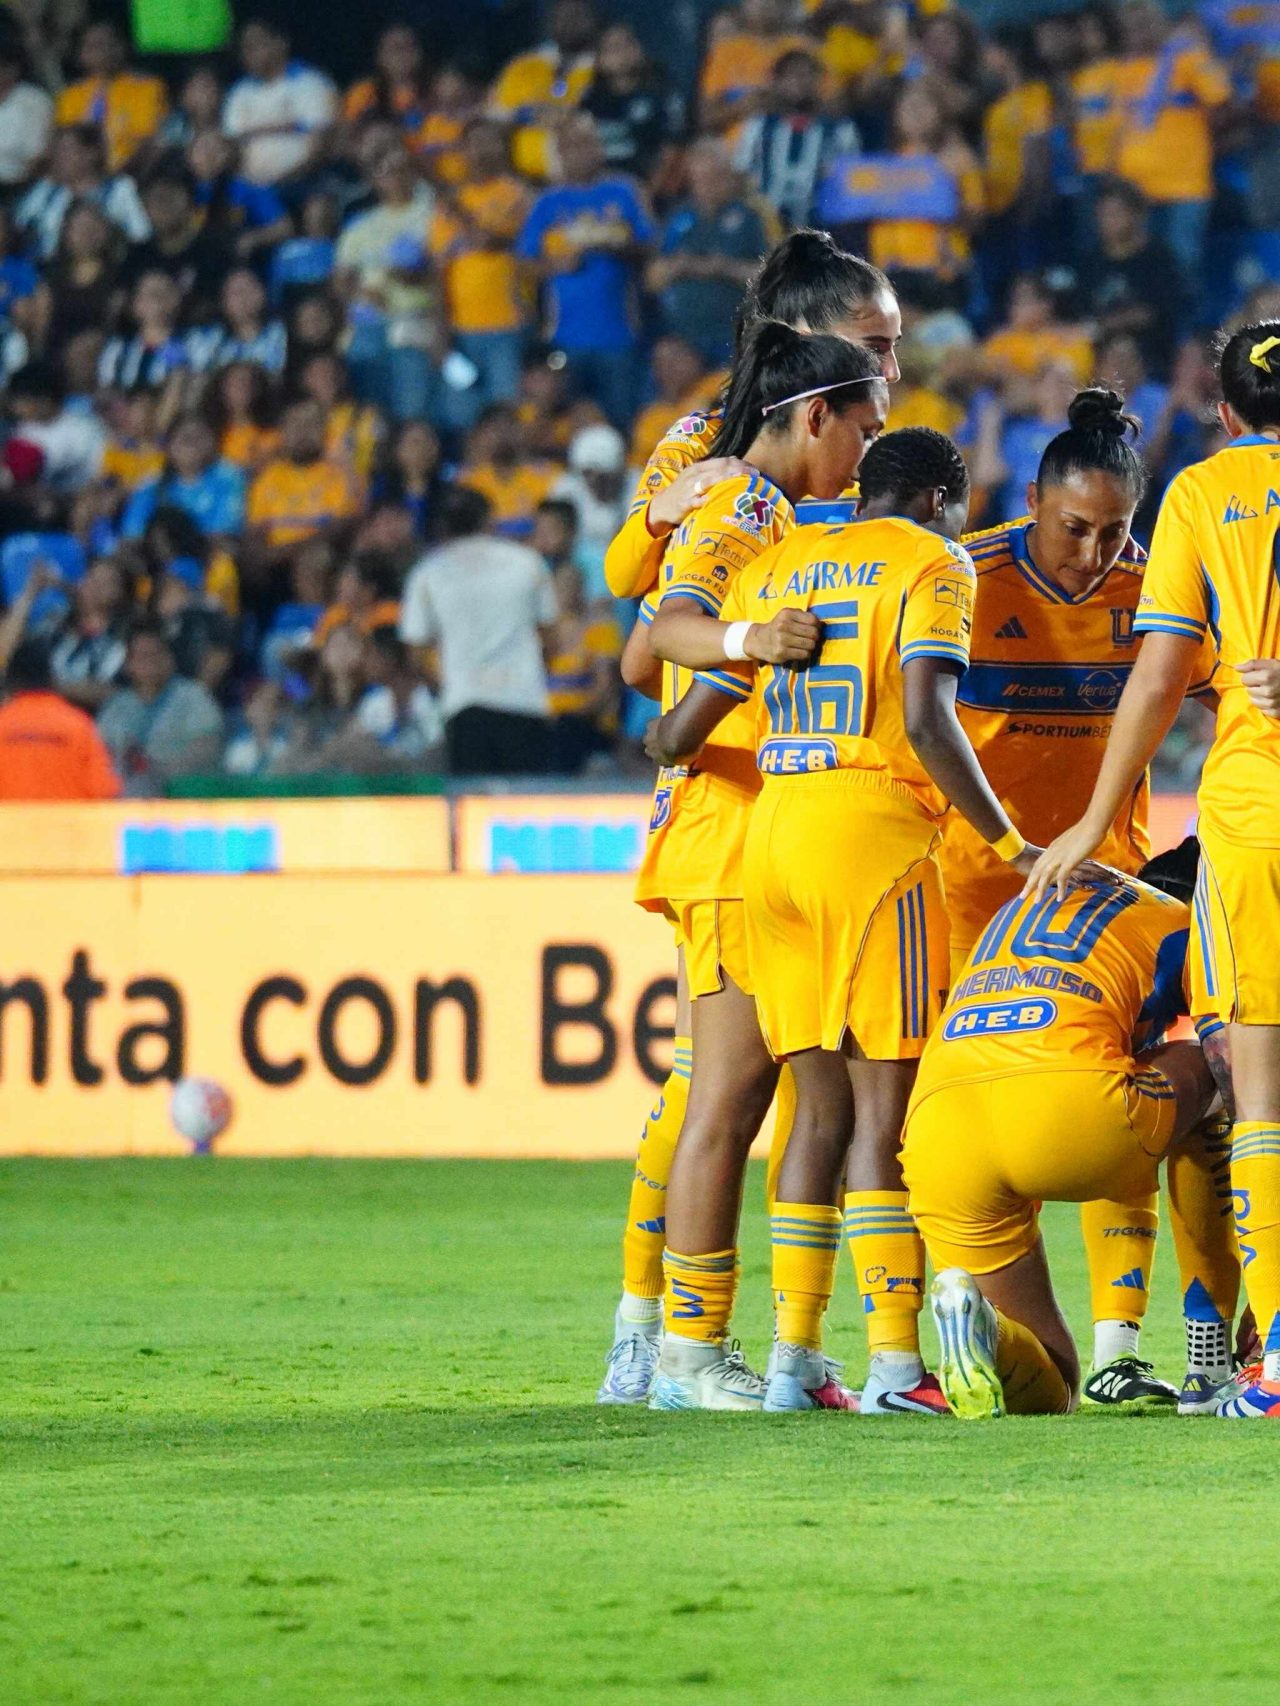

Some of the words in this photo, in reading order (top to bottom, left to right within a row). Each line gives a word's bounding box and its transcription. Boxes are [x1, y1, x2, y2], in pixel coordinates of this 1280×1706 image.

[784, 560, 887, 598] AFIRME
[1018, 686, 1066, 697] CEMEX
[971, 880, 1140, 966] 10
[950, 965, 1103, 1005] HERMOSO
[241, 976, 481, 1087] con
